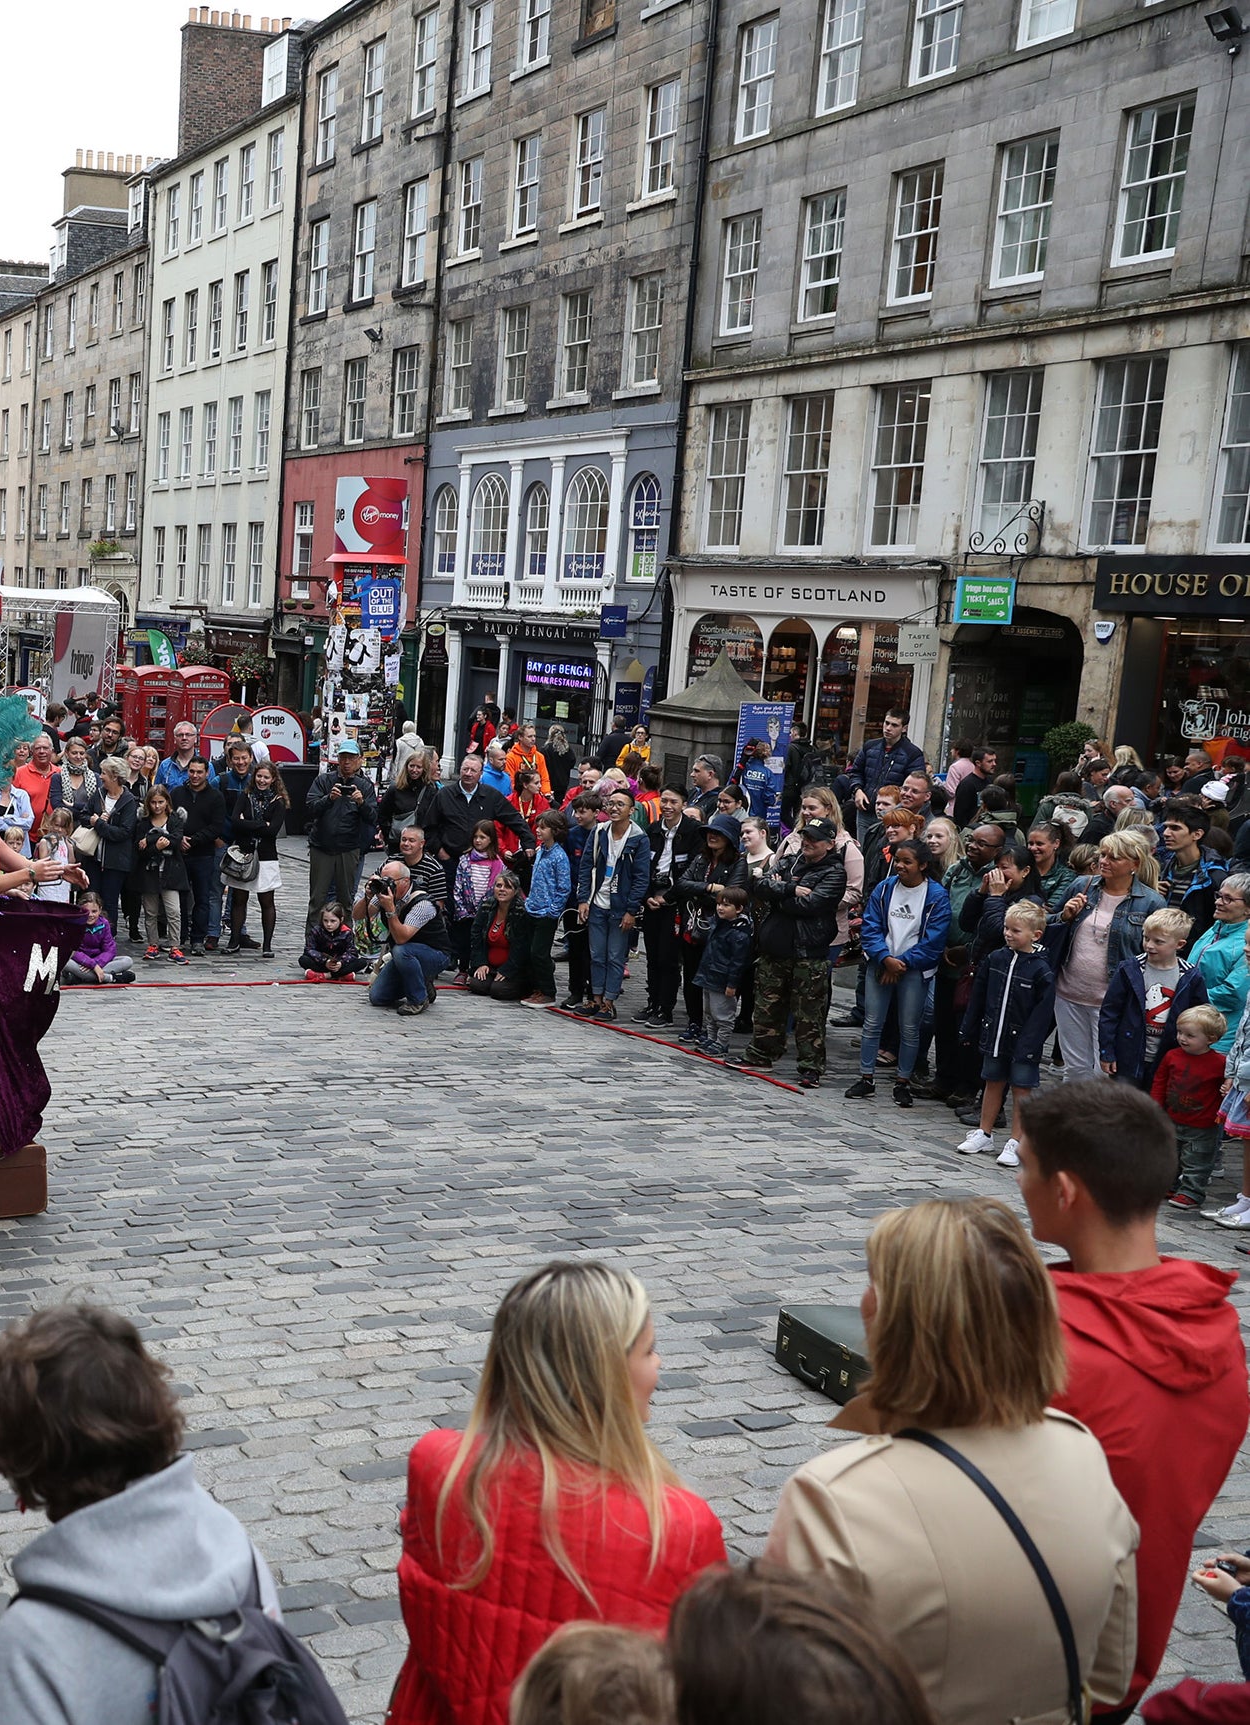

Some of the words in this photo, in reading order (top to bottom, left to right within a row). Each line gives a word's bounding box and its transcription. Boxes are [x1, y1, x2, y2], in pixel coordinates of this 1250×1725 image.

[379, 511, 399, 521] money
[1109, 573, 1210, 597] HOUSE
[371, 589, 393, 599] OUT
[710, 584, 757, 599] TASTE
[764, 586, 785, 599] OF
[791, 587, 886, 603] SCOTLAND
[987, 597, 1005, 607] SALES
[371, 606, 393, 614] BLUE
[484, 622, 501, 635] BAY
[506, 623, 519, 636] OF
[525, 625, 567, 639] BENGAL
[698, 636, 720, 648] Fudge,
[70, 649, 95, 680] fringe
[526, 661, 543, 673] BAY
[544, 663, 557, 674] OF
[525, 674, 549, 685] INDIAN
[549, 676, 595, 690] RESTAURAN
[261, 715, 285, 726] fringe
[1221, 728, 1231, 738] of
[1232, 727, 1250, 741] Elg
[746, 770, 765, 780] CSI:
[890, 911, 916, 920] adidas
